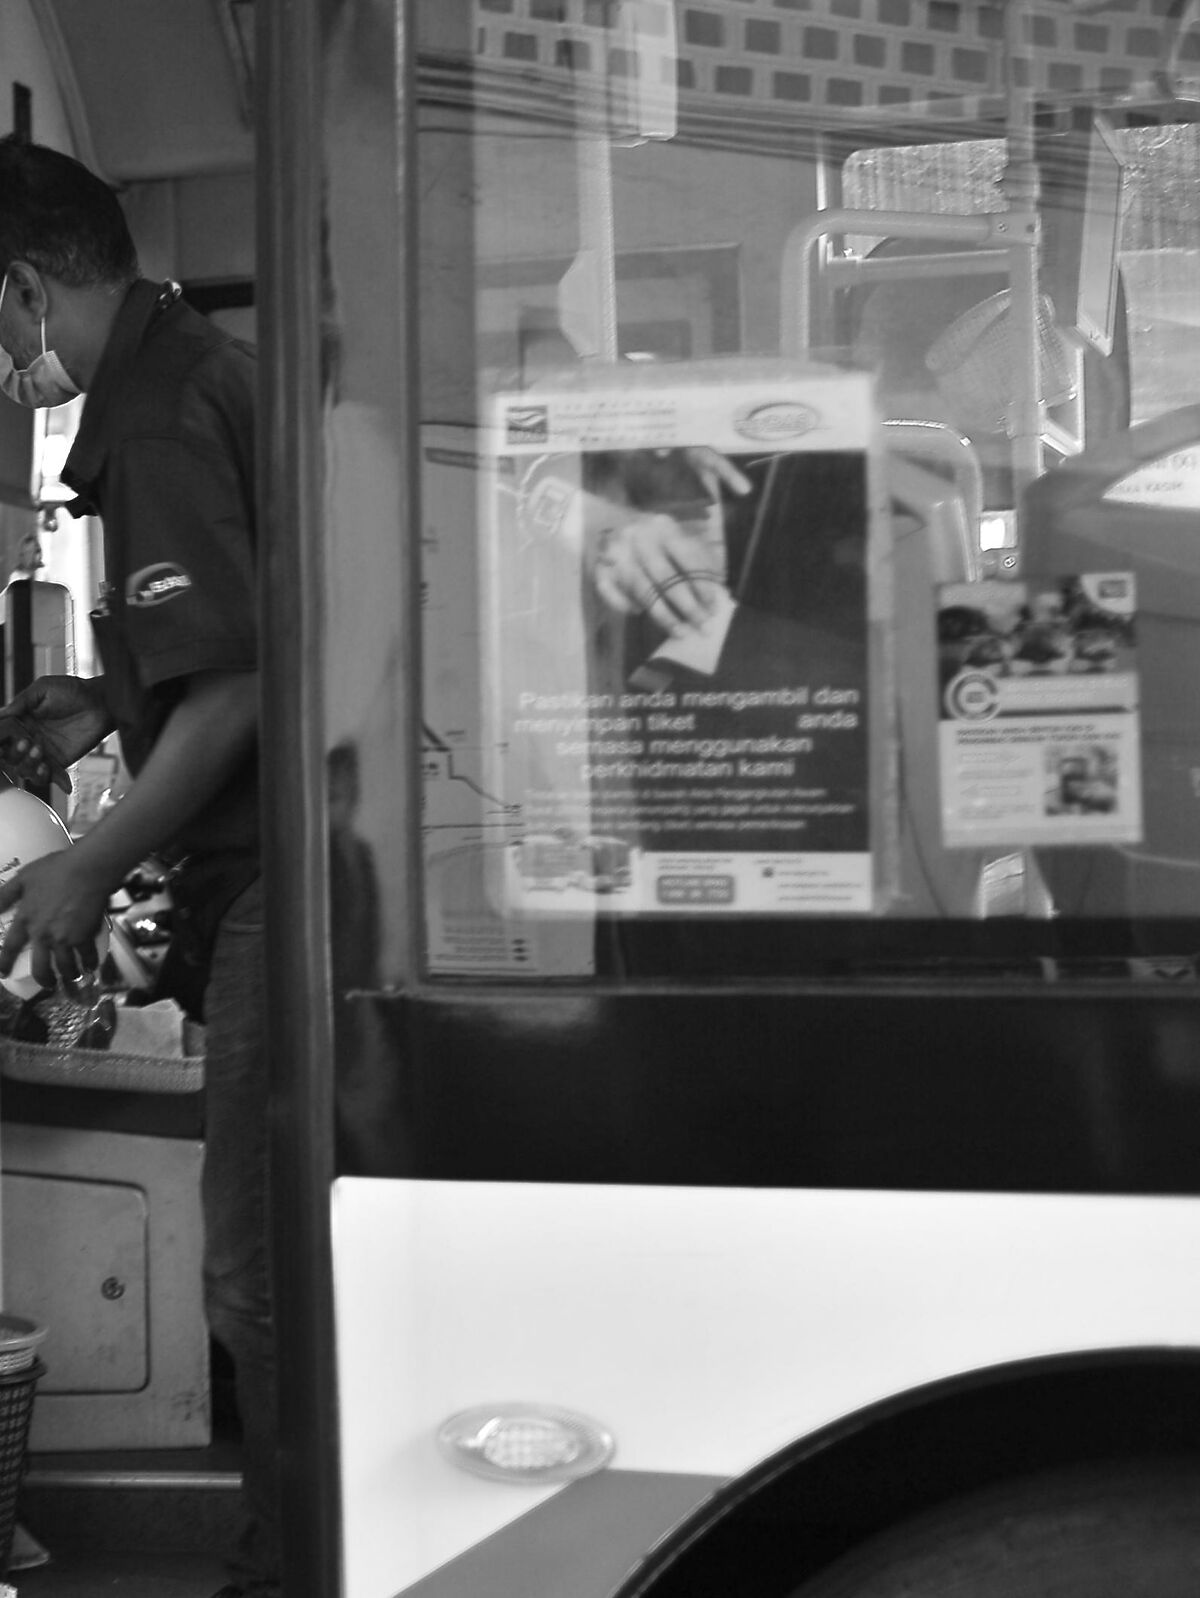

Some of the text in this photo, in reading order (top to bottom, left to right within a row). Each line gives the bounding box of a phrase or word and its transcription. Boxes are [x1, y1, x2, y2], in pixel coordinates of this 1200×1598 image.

[619, 690, 676, 708] anda
[681, 686, 810, 711] mengambil
[813, 685, 860, 705] dan
[647, 713, 696, 731] tiket
[797, 710, 859, 729] anda
[555, 734, 814, 758] semasa menggunakan
[580, 758, 796, 783] perkhidmatan kami
